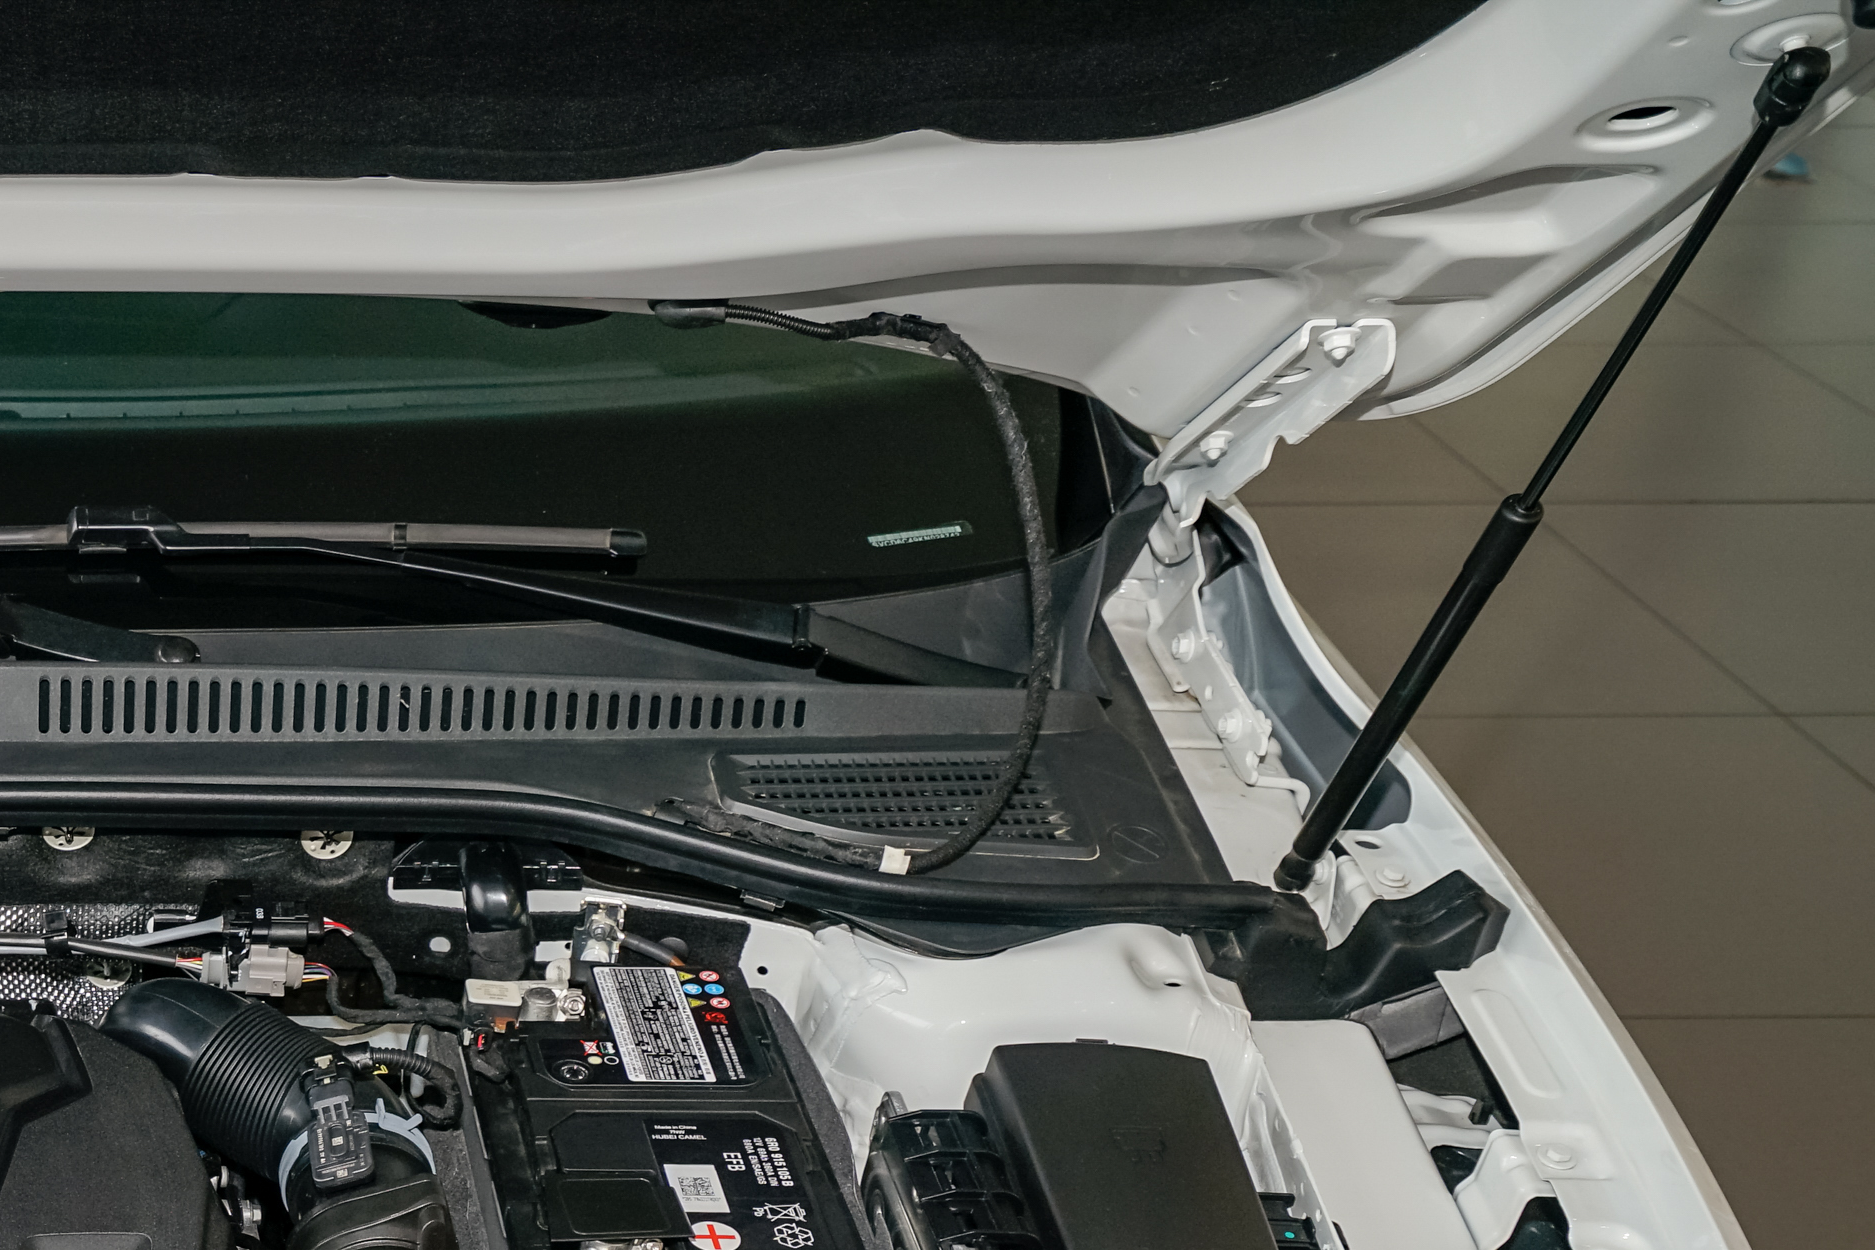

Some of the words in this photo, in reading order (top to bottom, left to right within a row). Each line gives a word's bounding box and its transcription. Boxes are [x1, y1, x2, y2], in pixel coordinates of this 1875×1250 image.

[722, 1152, 746, 1172] EFB
[771, 1154, 786, 1166] 915
[778, 1167, 791, 1180] 105
[753, 1207, 764, 1217] Pb
